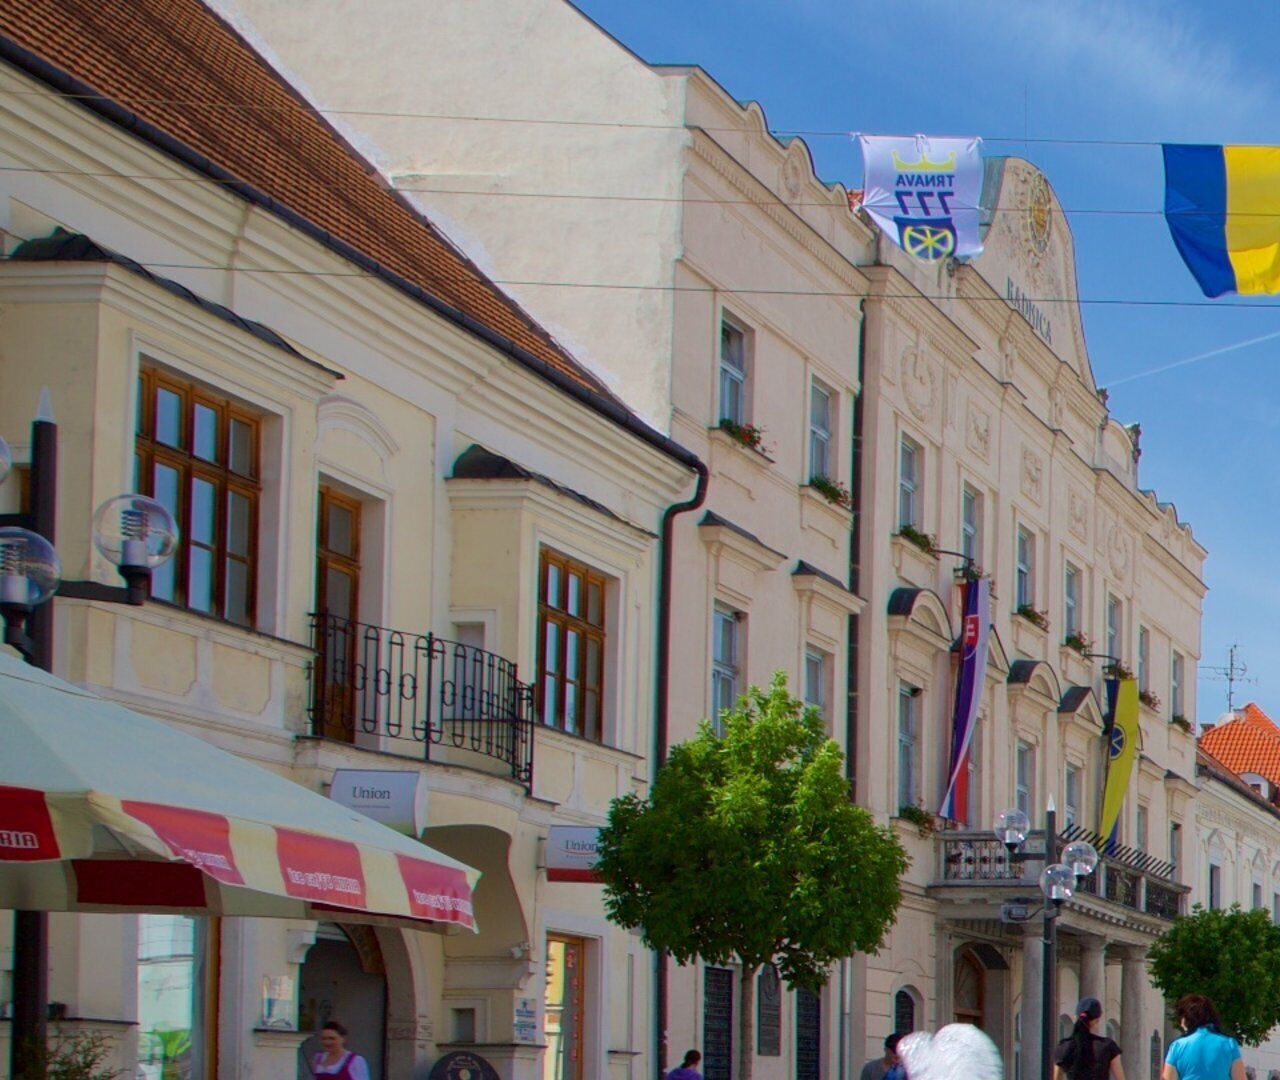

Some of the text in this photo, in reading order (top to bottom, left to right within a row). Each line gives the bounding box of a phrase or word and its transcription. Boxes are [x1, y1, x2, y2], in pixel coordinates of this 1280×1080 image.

[1006, 275, 1052, 345] RADNICA
[352, 785, 391, 800] Union
[565, 839, 599, 852] Union
